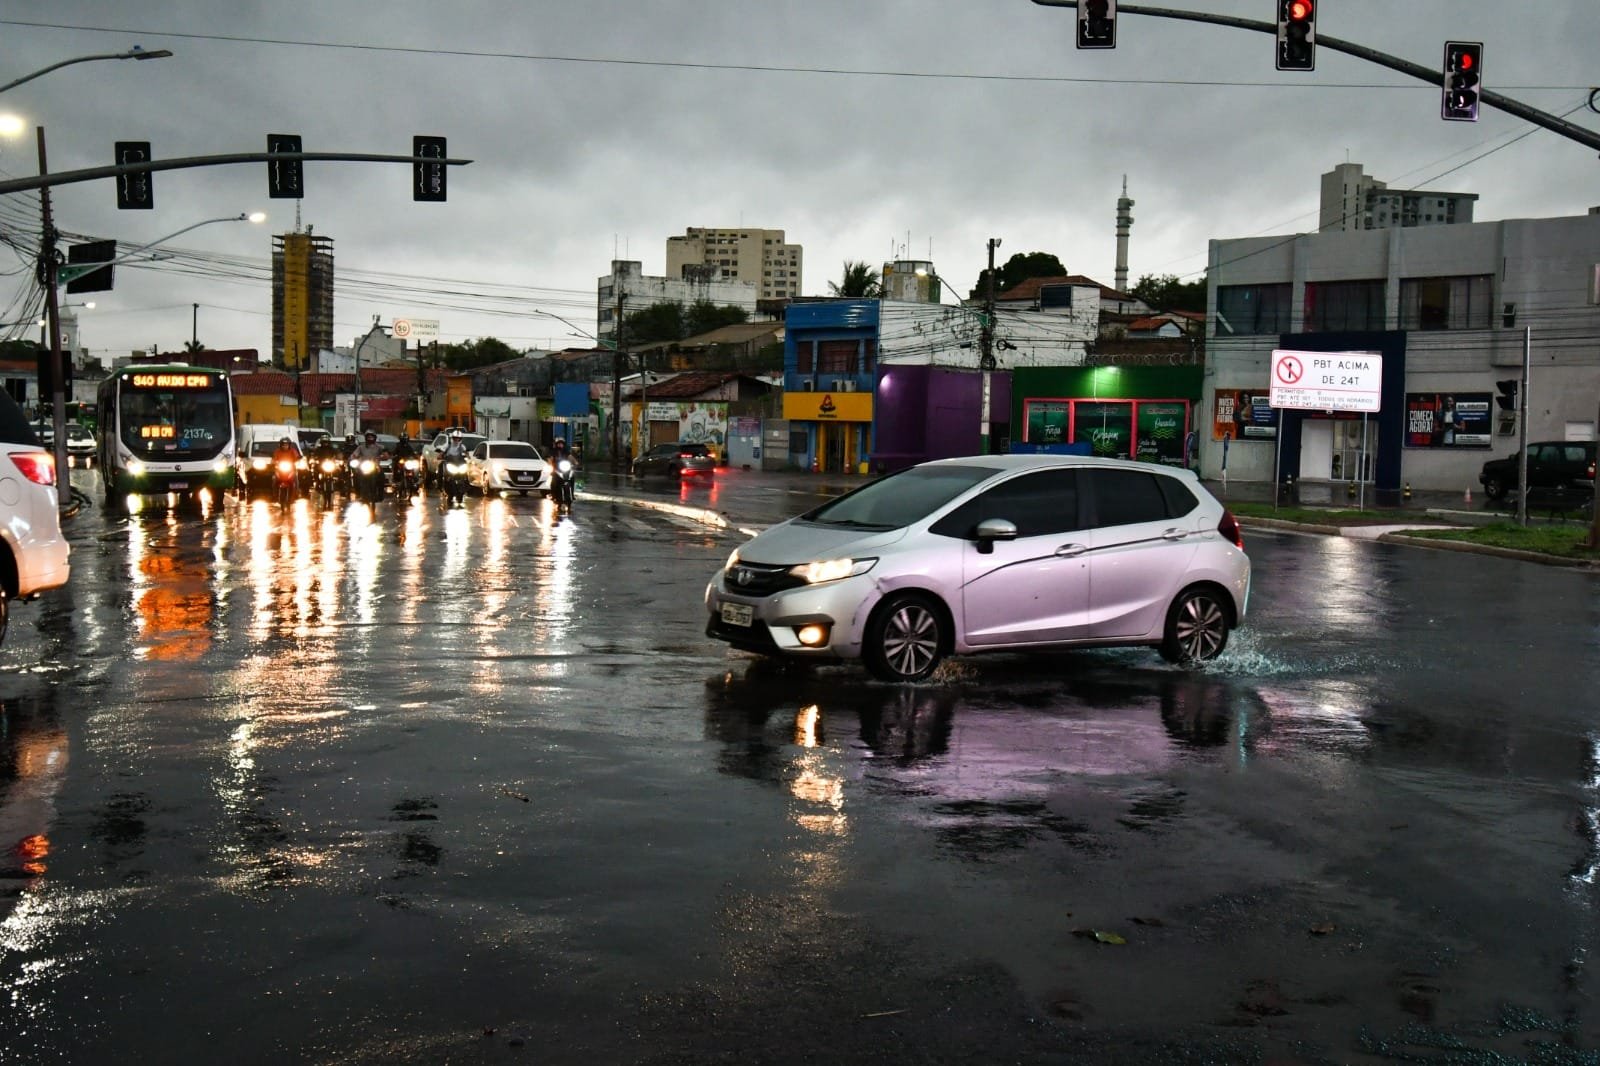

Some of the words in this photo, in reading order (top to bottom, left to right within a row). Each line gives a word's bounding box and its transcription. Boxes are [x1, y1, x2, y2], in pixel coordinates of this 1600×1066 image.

[1313, 359, 1332, 369] PBT
[1337, 360, 1370, 370] ACIMA
[133, 375, 155, 387] 340
[187, 375, 208, 387] CPA
[1322, 375, 1335, 384] DE
[1340, 376, 1360, 385] 24T
[1408, 420, 1433, 433] AGORA!
[183, 428, 205, 439] 2137
